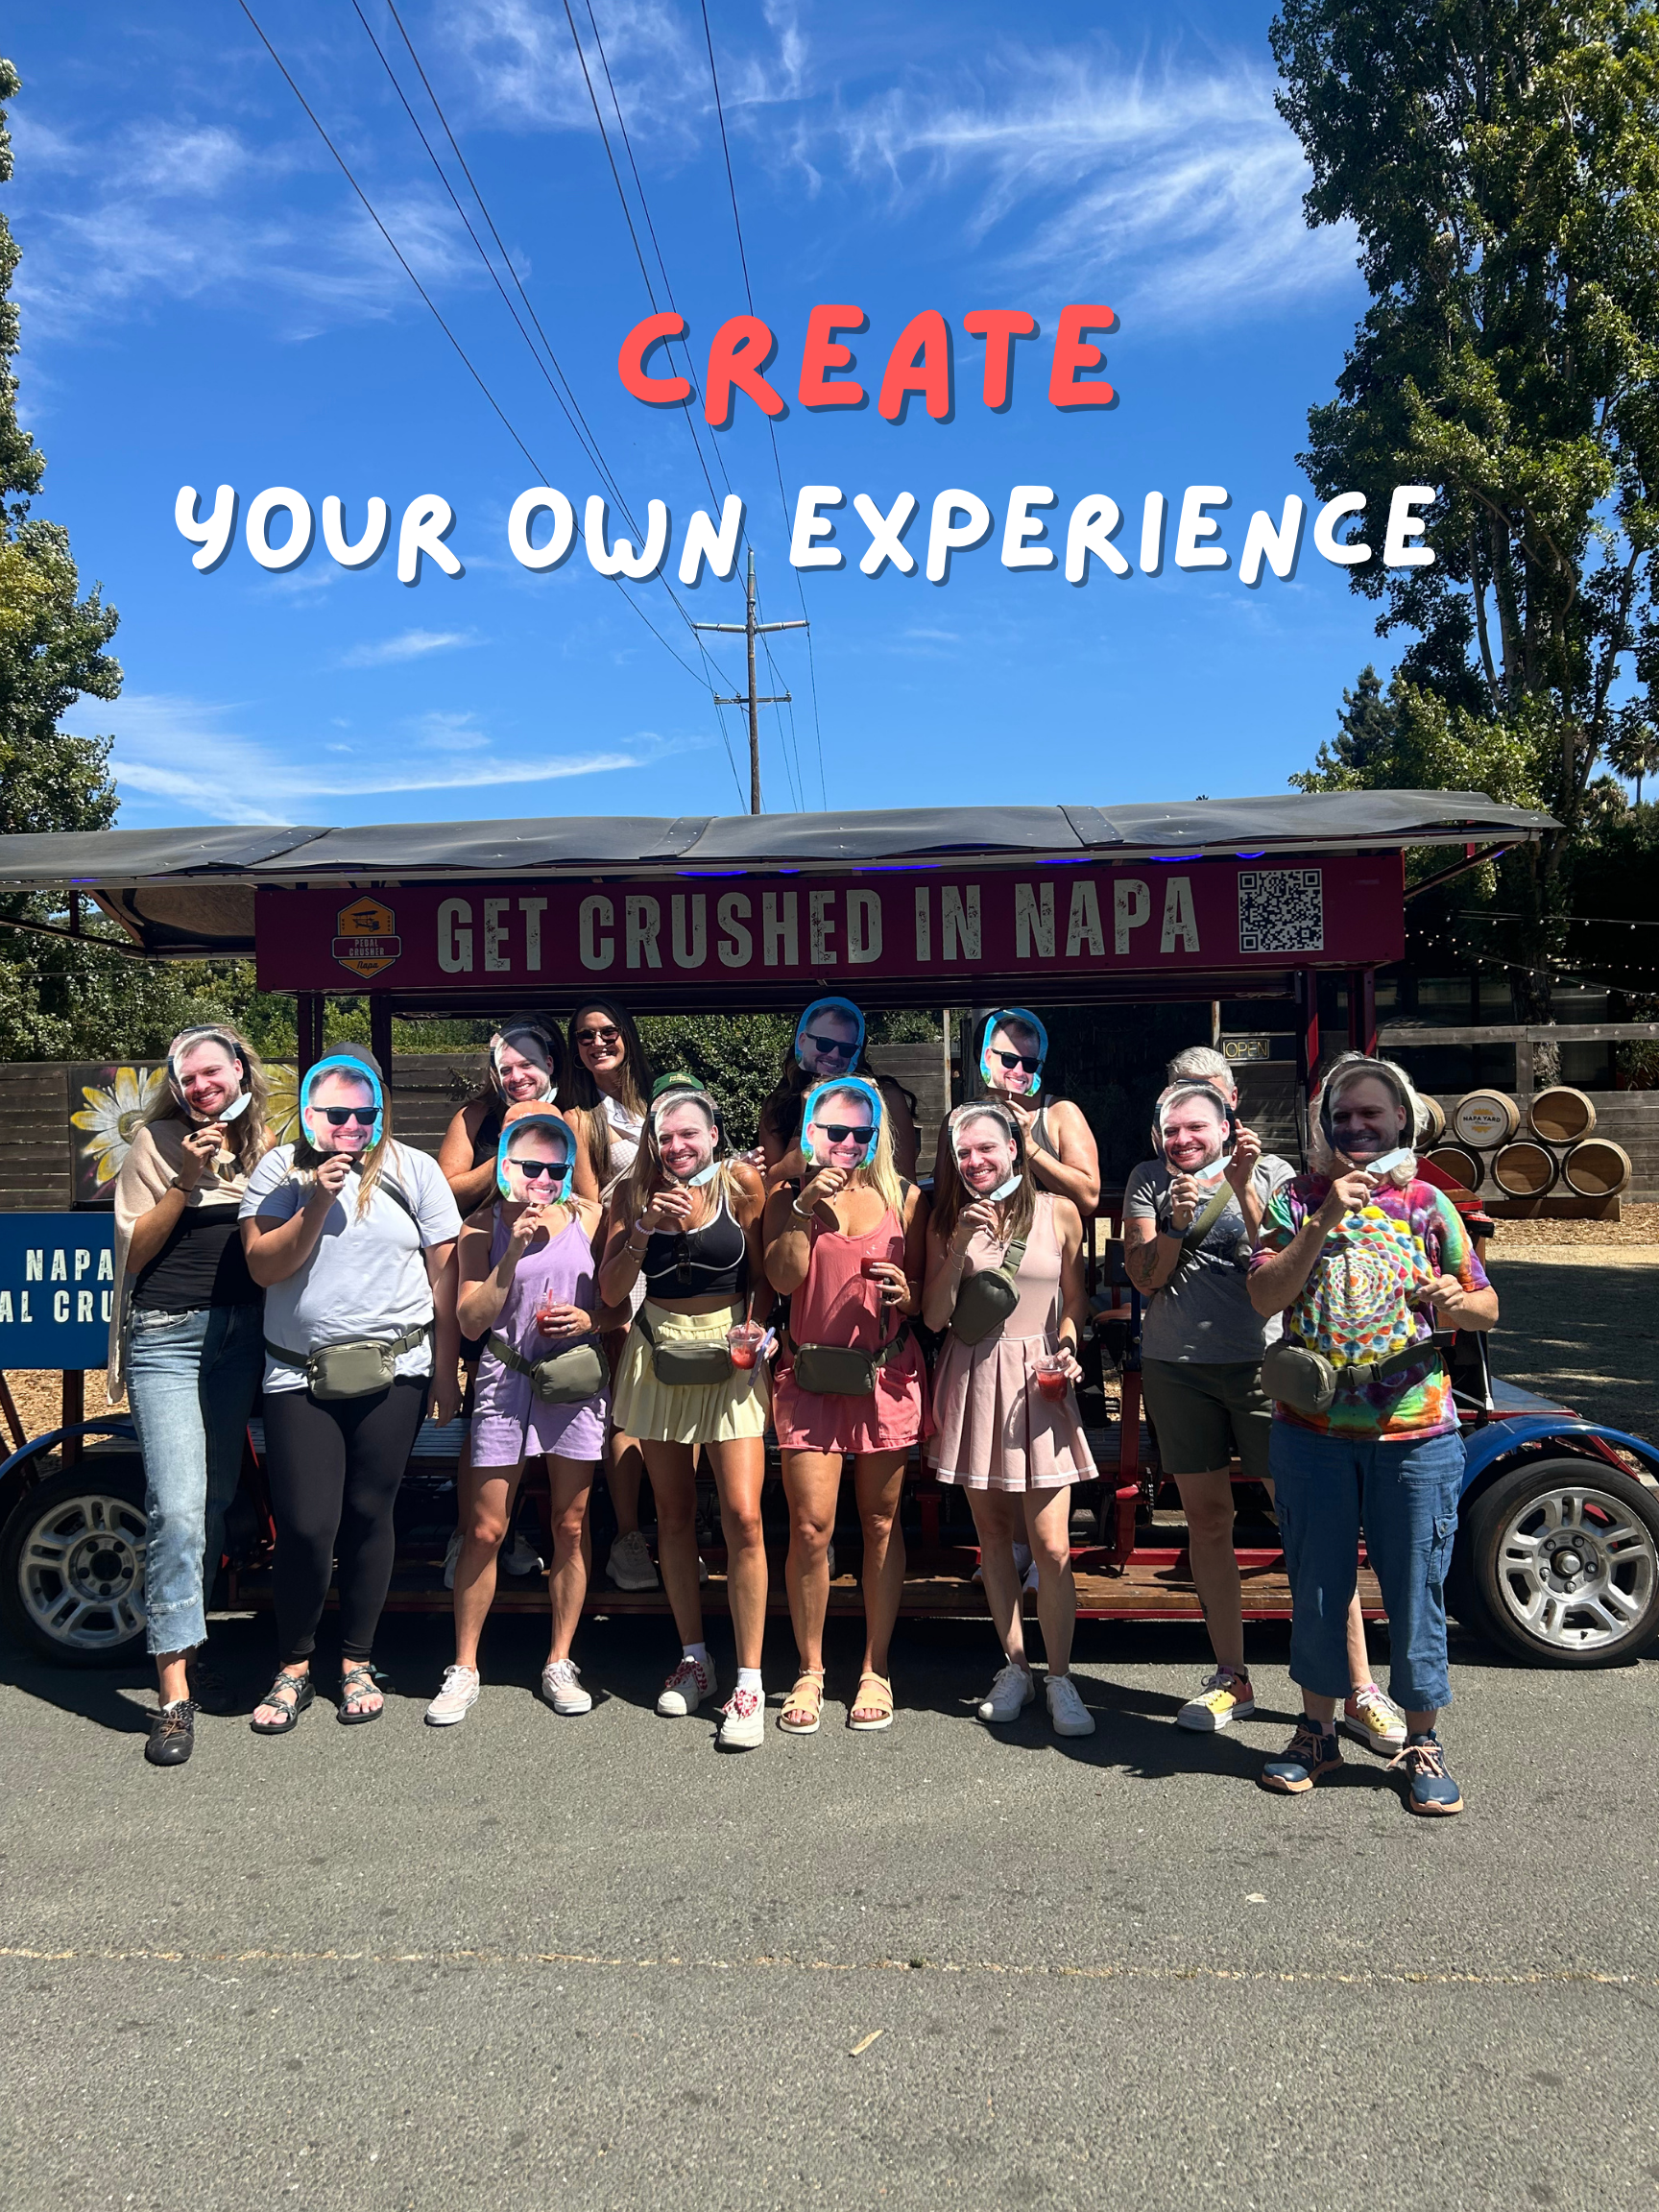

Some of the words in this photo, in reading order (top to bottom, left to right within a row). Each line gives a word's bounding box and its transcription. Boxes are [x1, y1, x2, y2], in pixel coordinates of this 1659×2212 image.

[437, 897, 548, 974] GET
[579, 889, 883, 971] CRUSHED
[915, 884, 982, 961] IN
[1015, 877, 1201, 958] NAPA
[349, 947, 385, 956] CRUSHER
[354, 938, 379, 948] PEDAL
[1225, 1041, 1267, 1058] OPEN
[26, 1248, 114, 1282] NAPA
